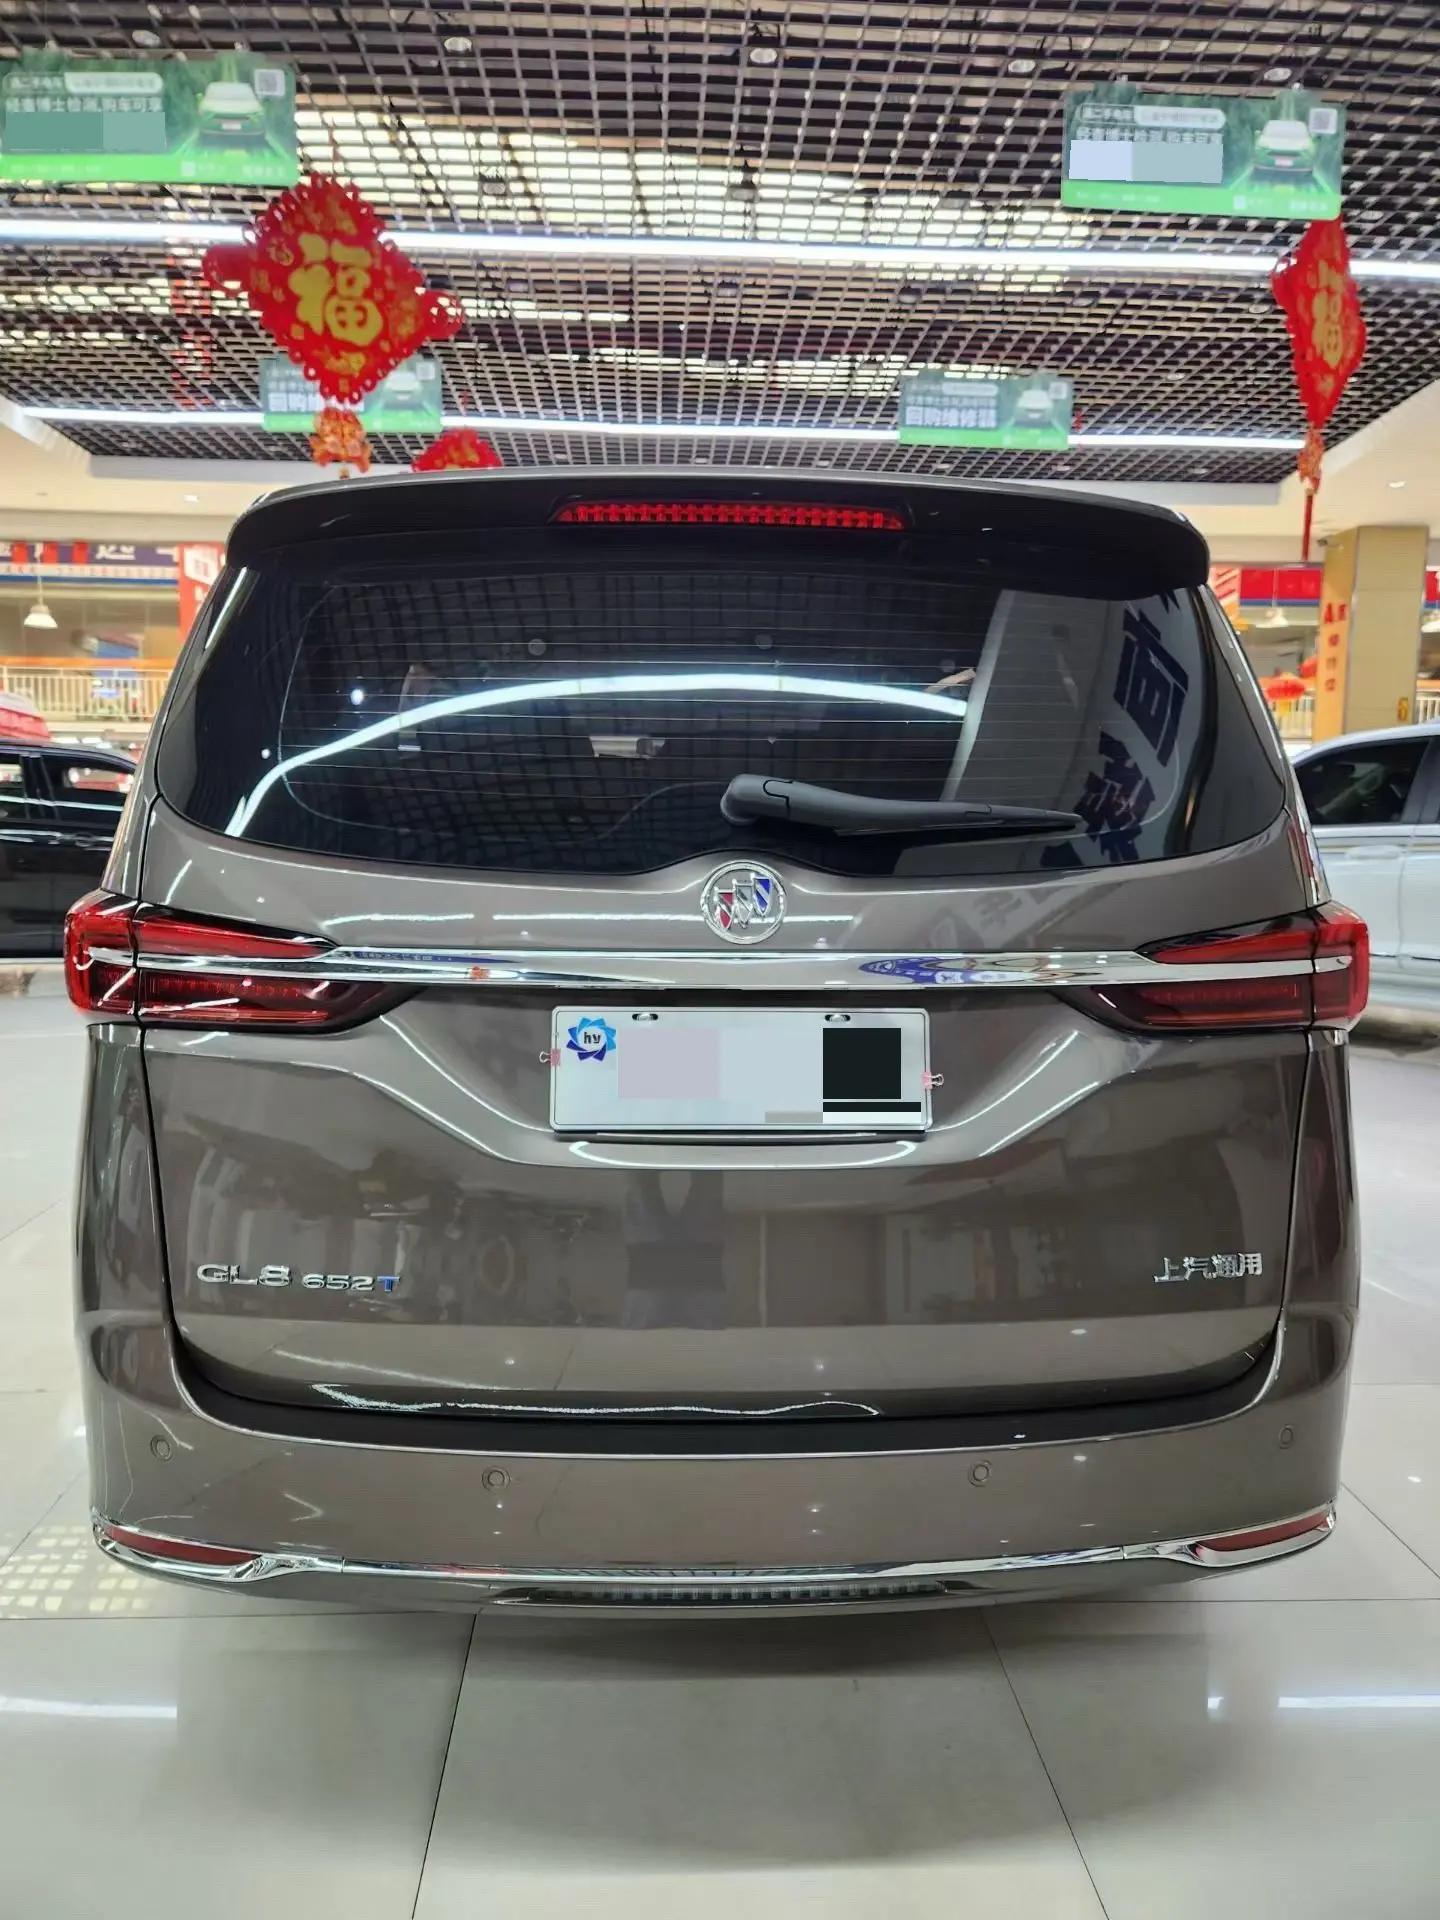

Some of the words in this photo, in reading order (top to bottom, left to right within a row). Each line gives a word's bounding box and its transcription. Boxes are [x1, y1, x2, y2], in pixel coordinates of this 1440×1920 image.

[197, 1263, 291, 1286] GL8
[302, 1273, 400, 1293] 652T
[1153, 1252, 1263, 1283] 上汽通用
